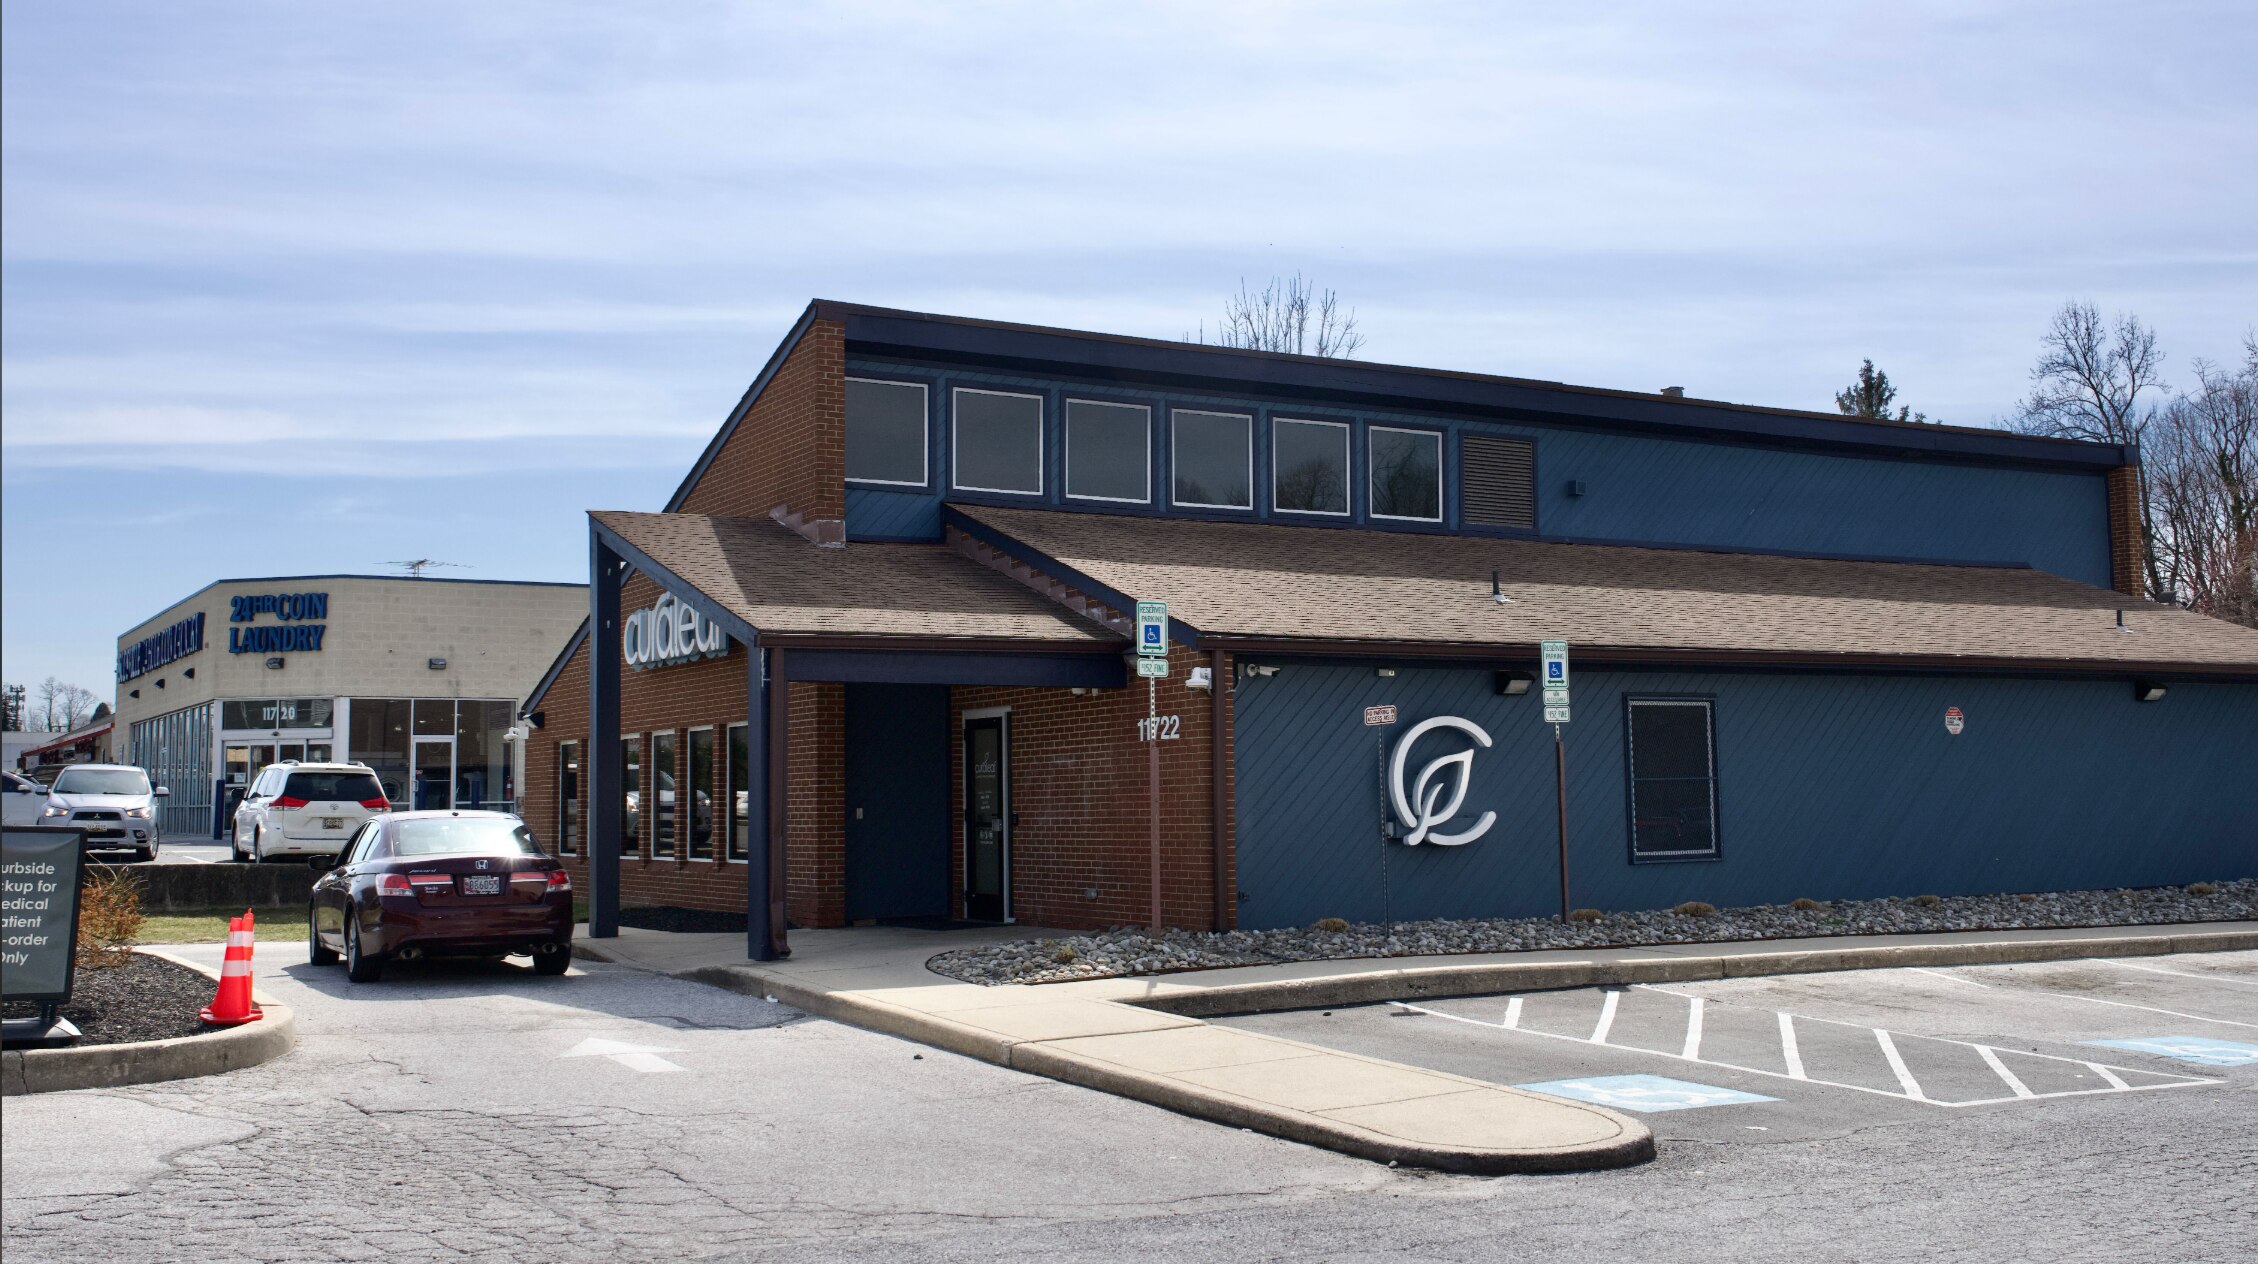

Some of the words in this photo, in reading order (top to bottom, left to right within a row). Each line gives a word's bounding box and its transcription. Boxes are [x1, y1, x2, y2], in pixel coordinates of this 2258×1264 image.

[276, 592, 328, 621] COIN
[1140, 606, 1165, 614] RESERVED
[624, 591, 720, 665] curalea
[1141, 615, 1164, 623] PARKING
[229, 625, 326, 653] LAUNDRY
[1154, 663, 1165, 673] FINE
[1137, 715, 1180, 741] 11722
[38, 880, 57, 892] for
